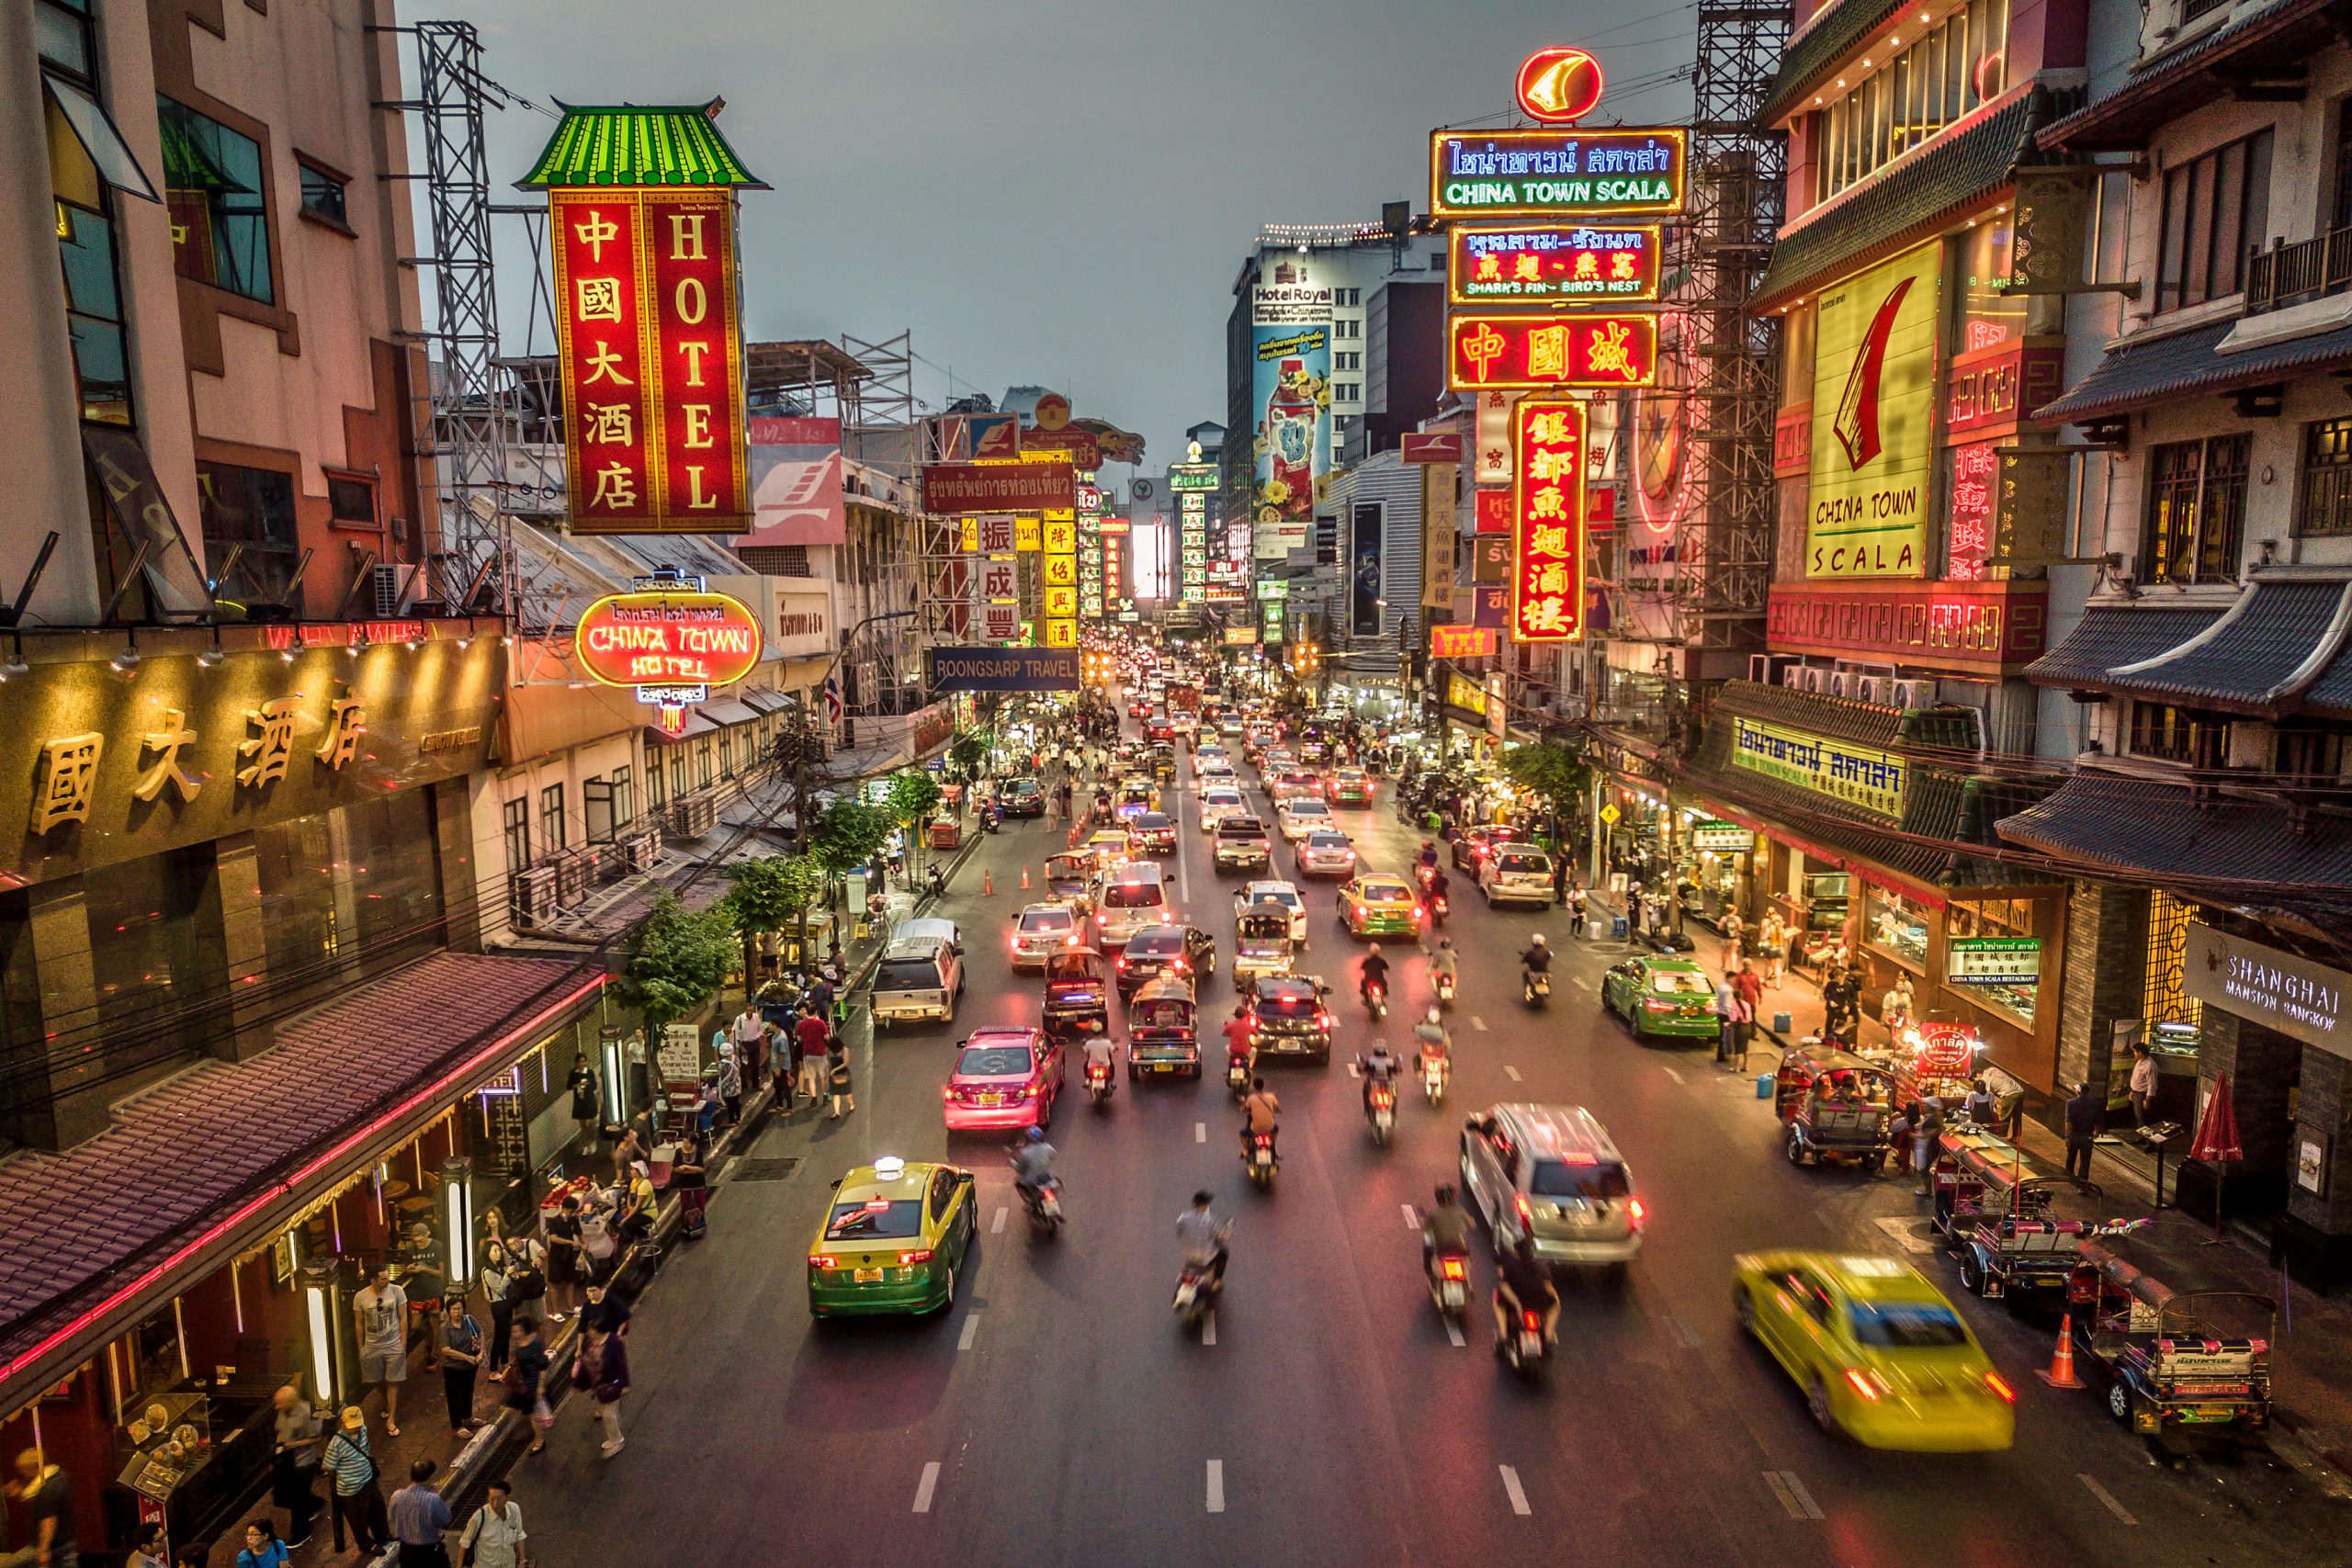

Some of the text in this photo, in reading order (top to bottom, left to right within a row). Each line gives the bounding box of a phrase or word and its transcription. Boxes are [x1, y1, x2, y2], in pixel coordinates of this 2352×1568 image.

[1449, 141, 1669, 175] ไชน่าทาวน์ สกาล่า
[1447, 181, 1671, 204] CHINA TOWN SCALA
[1256, 287, 1332, 304] Hotel Royal
[1467, 280, 1522, 294] SHARK'S
[1562, 279, 1605, 293] BIRD'S
[1608, 279, 1641, 292] NEST
[573, 210, 639, 511] 中國大酒店
[668, 214, 718, 511] HOTEL
[1463, 321, 1637, 383] 中國城
[928, 466, 1069, 507] รุ่งทรัพย์การท่องเที่ยว
[1816, 486, 1917, 526] CHINA TOWN
[1814, 543, 1913, 573] SCALA
[980, 521, 1019, 639] 振成豐
[589, 626, 751, 654] CHINA TOWN
[631, 655, 711, 680] HOTEL
[936, 659, 1075, 679] ROONGSARP TRAVEL
[1737, 718, 1900, 794] ไชน่าทาวน์ สกาล่า
[2228, 954, 2338, 1014] SHANGHAI
[2225, 979, 2336, 1032] MANSION BANGKOK
